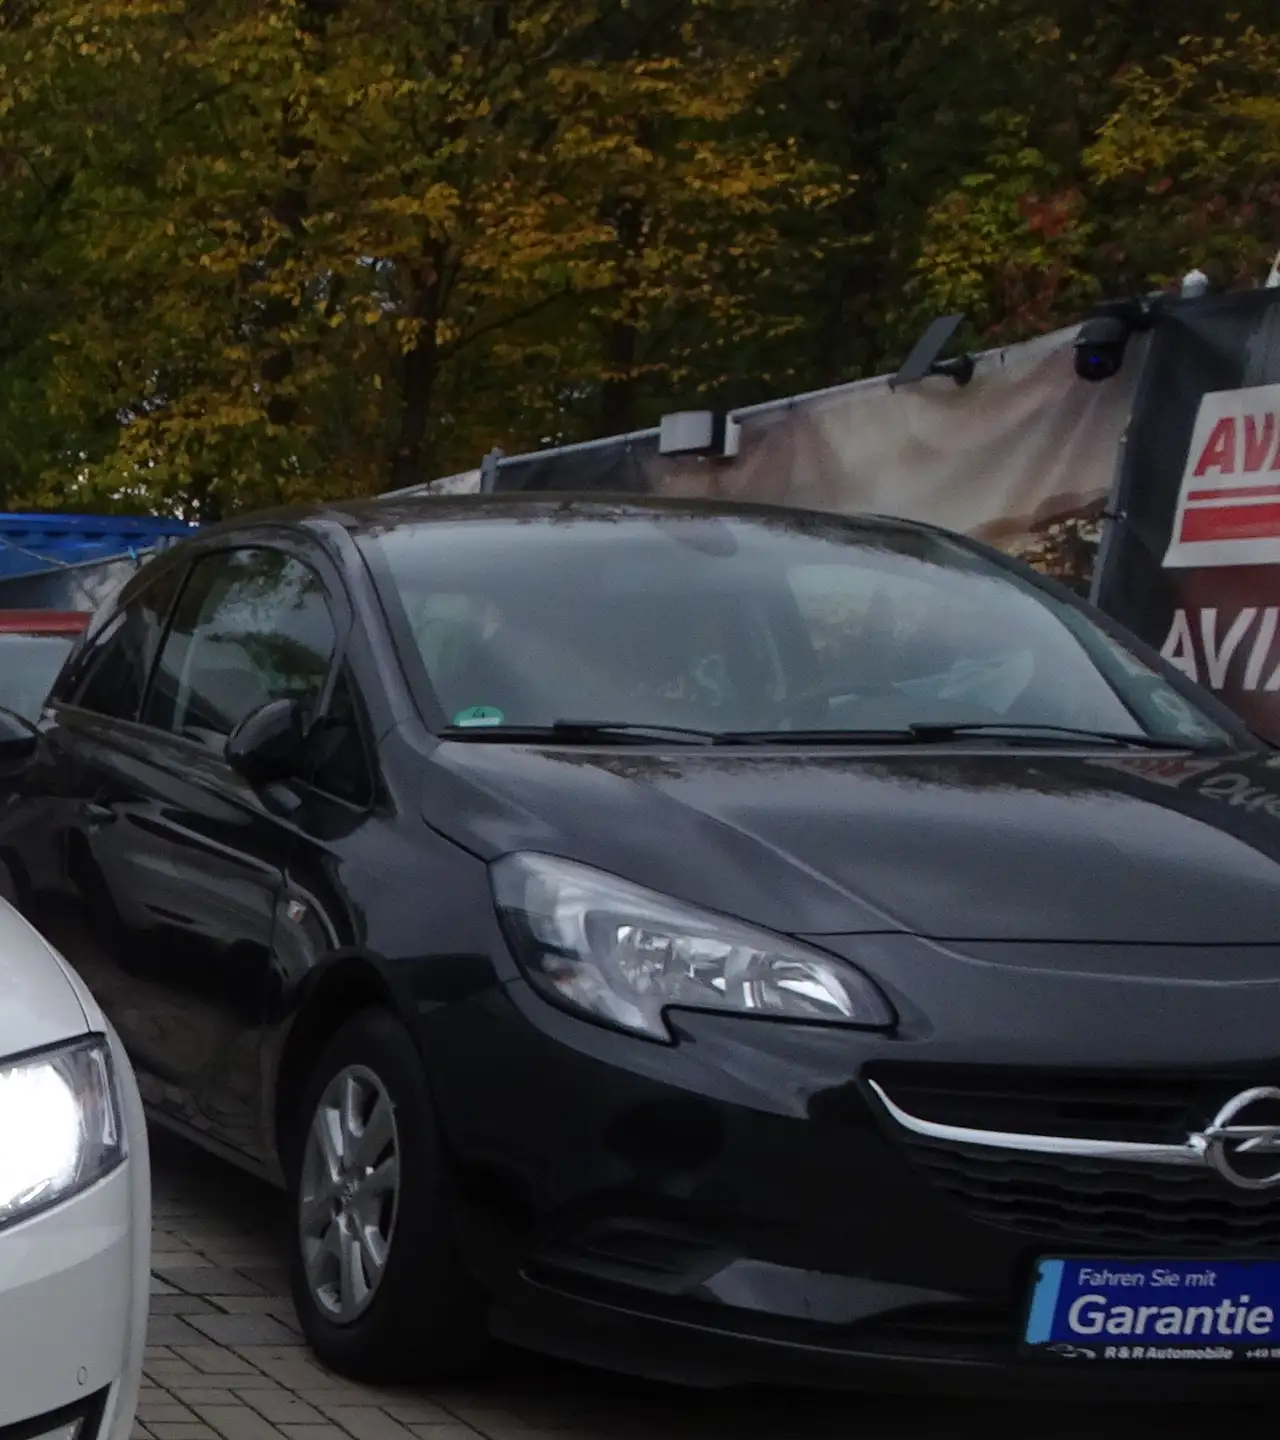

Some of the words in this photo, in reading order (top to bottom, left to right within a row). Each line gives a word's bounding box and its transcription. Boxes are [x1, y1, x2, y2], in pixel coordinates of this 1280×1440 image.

[1160, 606, 1280, 690] AVI
[1078, 1268, 1144, 1287] Fahren
[1149, 1269, 1180, 1287] Sie
[1185, 1270, 1217, 1287] mit
[1068, 1294, 1274, 1335] Garantie
[1146, 1347, 1233, 1360] Automobile
